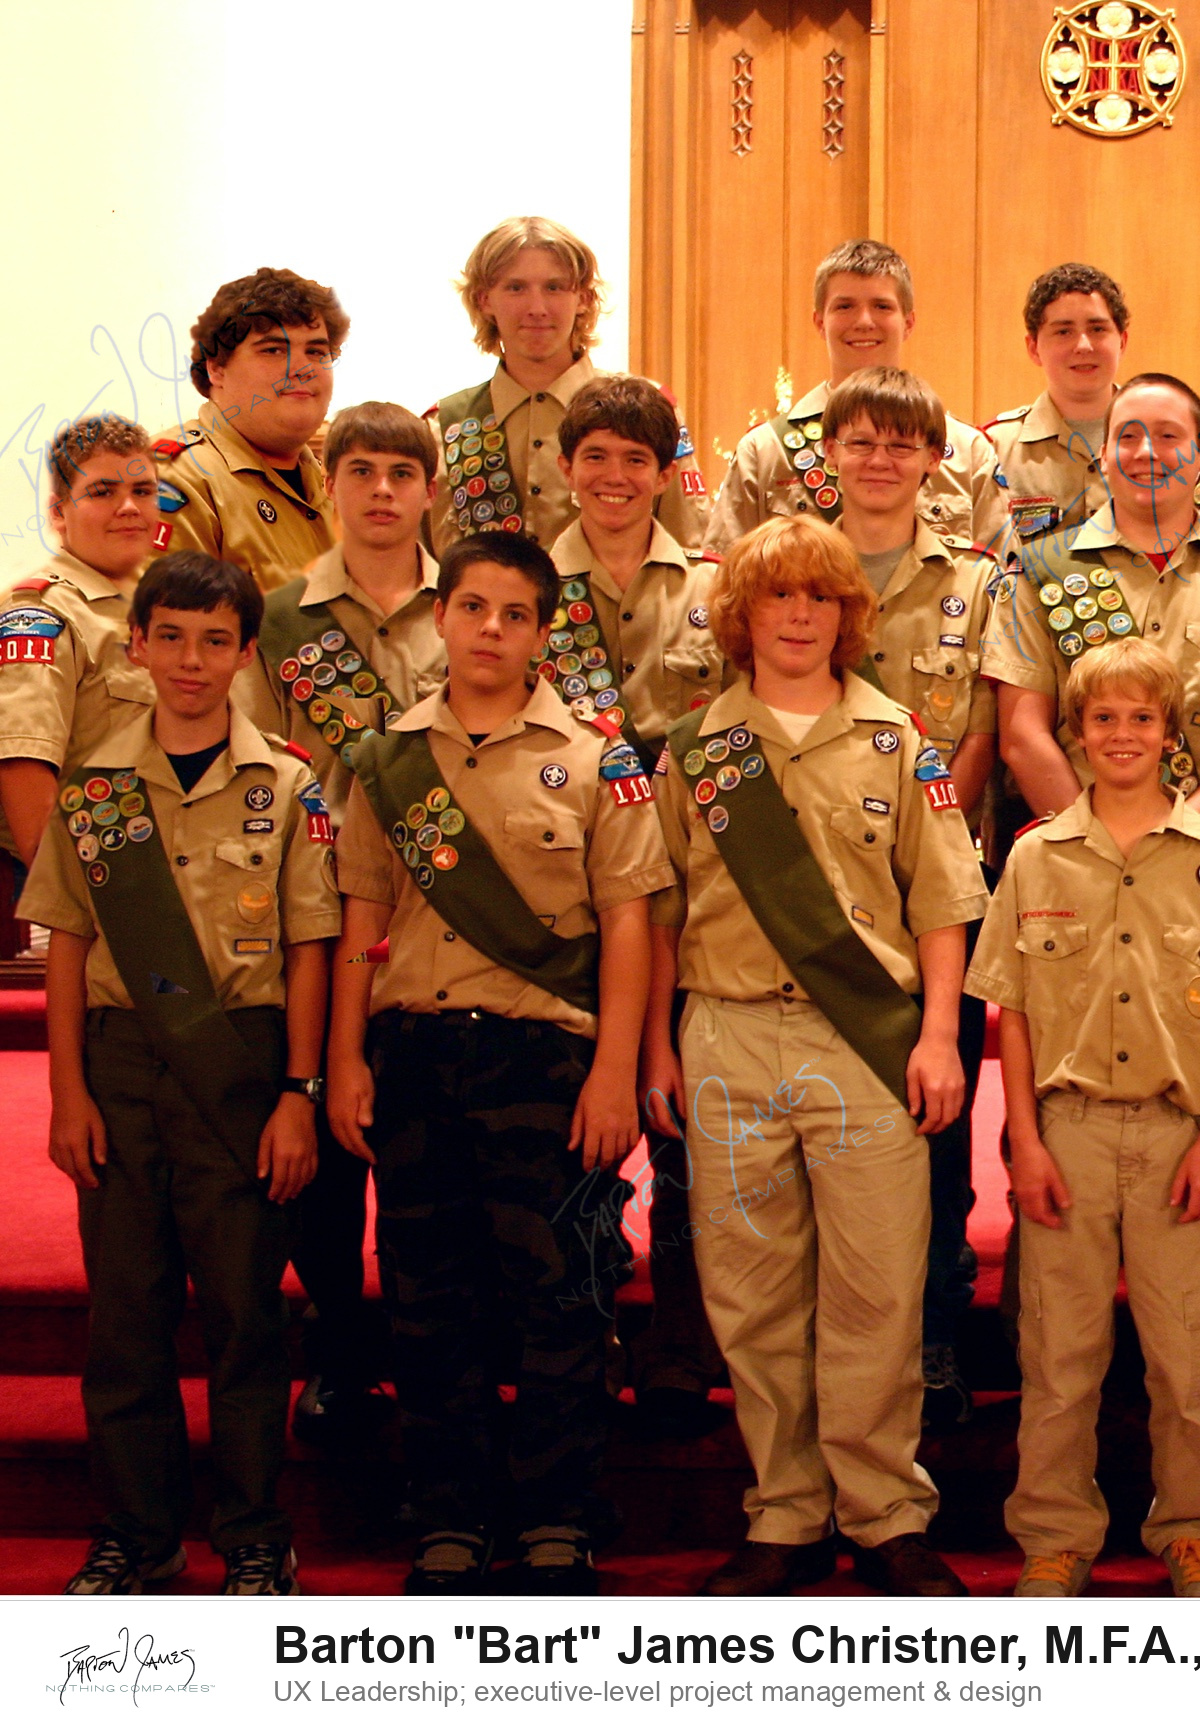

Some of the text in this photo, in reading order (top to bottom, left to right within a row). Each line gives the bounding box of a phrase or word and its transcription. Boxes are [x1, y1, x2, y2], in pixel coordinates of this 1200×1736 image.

[614, 776, 652, 804] 110
[929, 783, 957, 807] 110
[311, 816, 334, 841] 11
